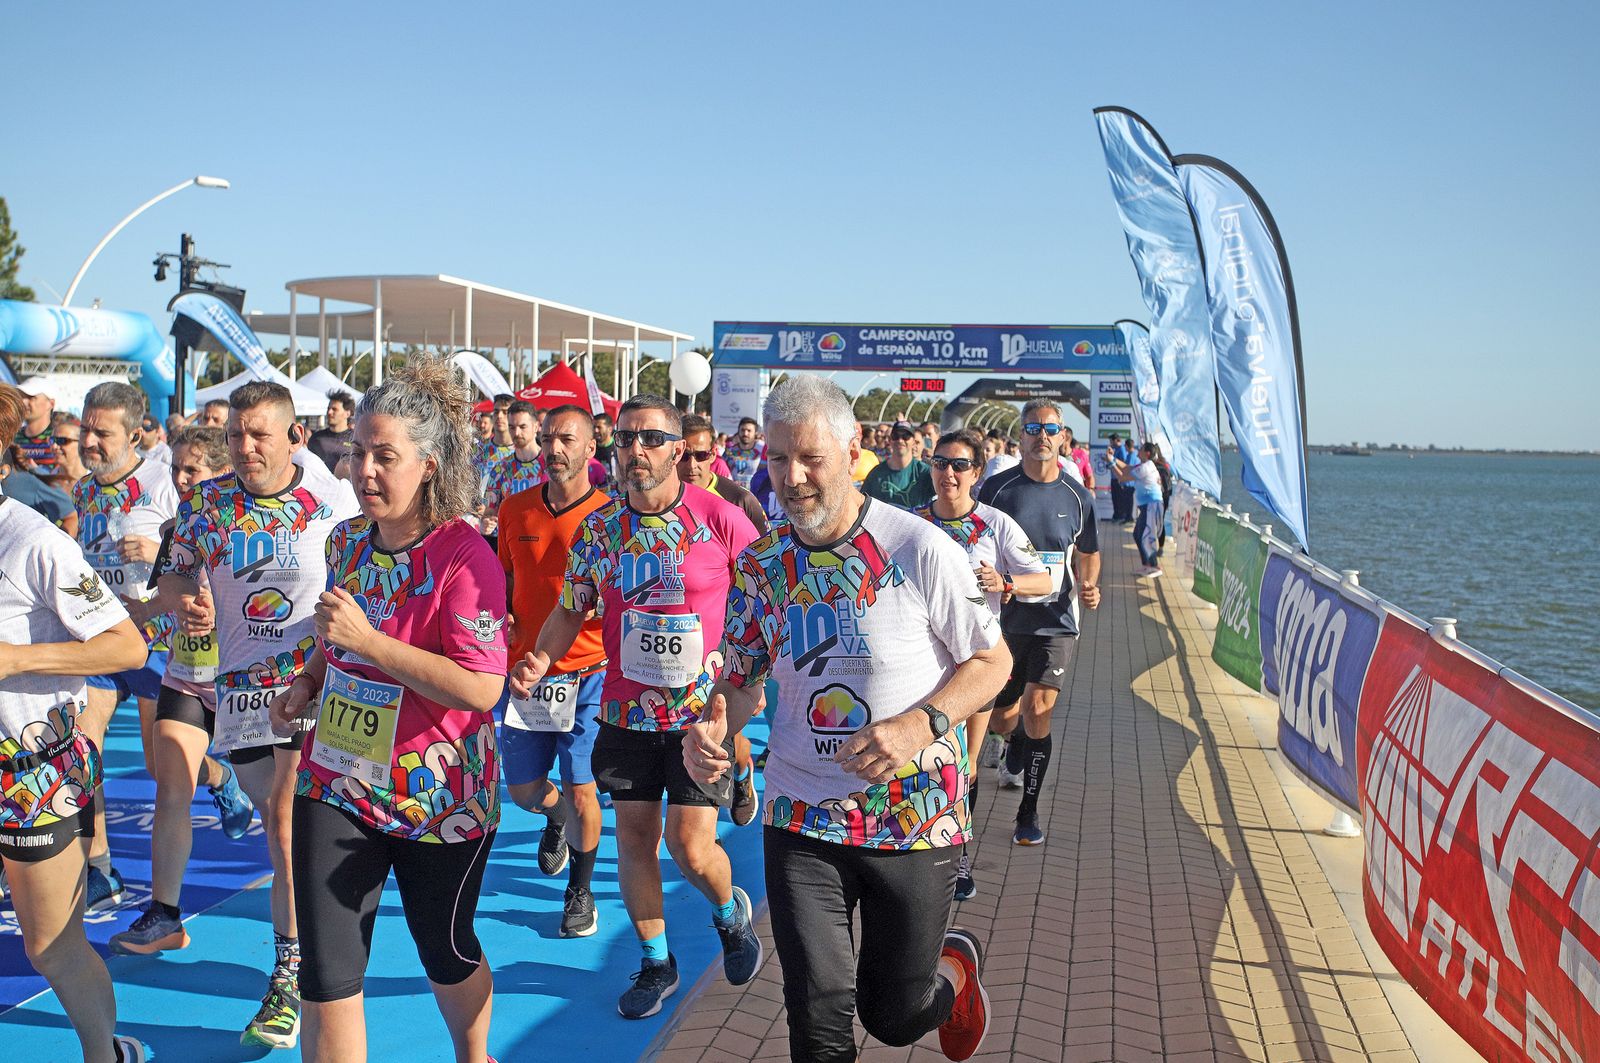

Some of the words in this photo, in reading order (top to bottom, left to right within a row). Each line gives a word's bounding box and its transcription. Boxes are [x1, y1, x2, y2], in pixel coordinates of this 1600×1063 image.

[859, 329, 955, 341] CAMPEONATO
[858, 344, 873, 355] de
[876, 343, 924, 356] ESPAÑA
[932, 343, 954, 358] 10
[959, 342, 988, 358] km
[1026, 340, 1064, 353] HUELVA
[1098, 343, 1127, 355] WiH
[921, 358, 954, 366] Absoluto
[276, 530, 299, 542] HU
[230, 530, 274, 582] 10
[276, 543, 299, 555] EL
[276, 556, 300, 568] VA
[661, 551, 684, 564] HU
[661, 564, 685, 577] EL
[620, 552, 660, 606] 10
[661, 577, 684, 589] VA
[368, 598, 397, 619] HU
[837, 600, 866, 618] HU
[247, 624, 283, 638] WiHu
[673, 620, 695, 630] 2023
[840, 619, 869, 637] EL
[177, 632, 212, 652] 1268
[640, 633, 682, 655] 586
[786, 602, 838, 677] 10
[840, 637, 872, 655] VA
[828, 667, 874, 676] DESCUBRIMIENTO
[842, 659, 862, 668] PUERTA
[863, 659, 872, 668] DEL
[362, 687, 391, 704] 2023
[525, 684, 567, 703] 406
[226, 690, 276, 714] 1080
[329, 697, 379, 737] 1779
[341, 734, 351, 744] DEL
[351, 738, 371, 750] PRADO
[814, 738, 843, 754] Wi
[16, 832, 54, 847] TRAINING
[1419, 897, 1583, 1063] ATLE
